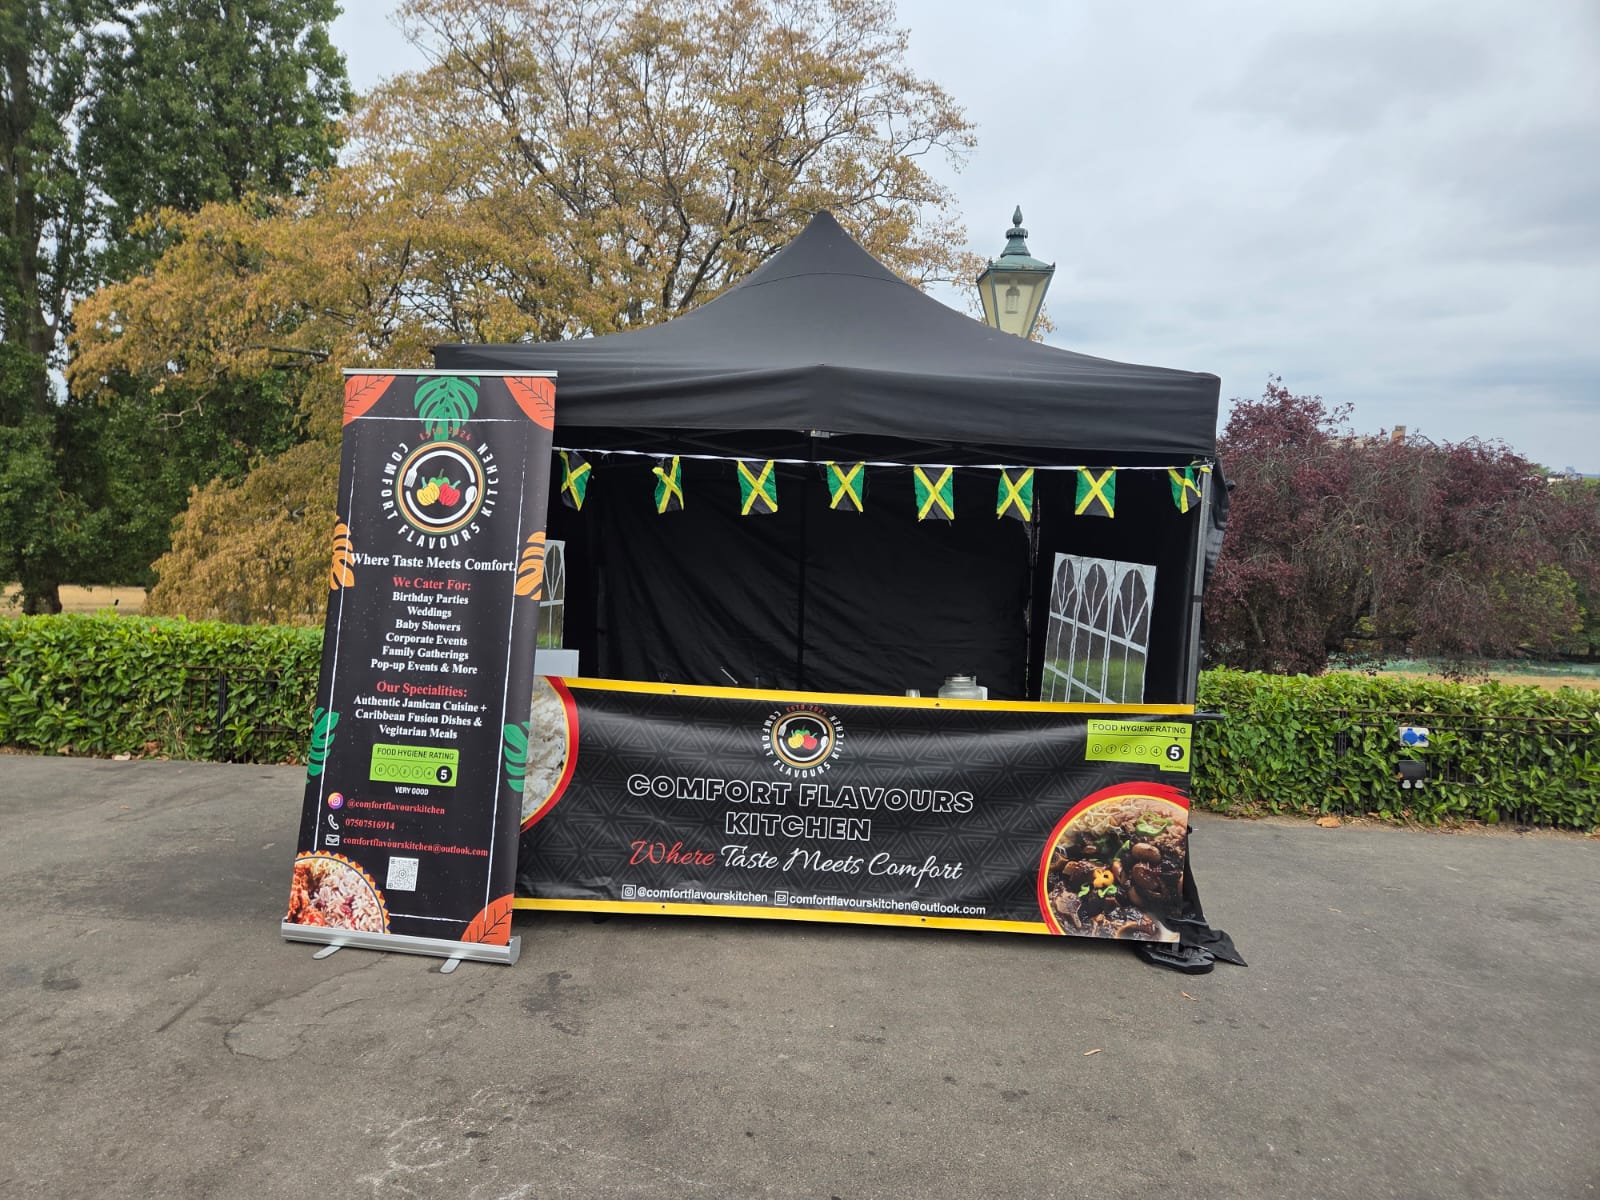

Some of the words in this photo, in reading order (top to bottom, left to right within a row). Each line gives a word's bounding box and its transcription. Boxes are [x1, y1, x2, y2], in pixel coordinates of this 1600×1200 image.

[381, 442, 409, 520] COMFORT
[397, 522, 480, 549] FLAVOURS
[480, 442, 499, 517] KITCHEN
[351, 552, 389, 566] Where
[392, 554, 423, 568] Taste
[427, 556, 461, 569] Meets
[393, 576, 410, 588] We
[413, 577, 444, 589] Cater
[447, 579, 471, 591] For:
[392, 591, 434, 605] Birthday
[436, 593, 469, 605] Parties
[407, 606, 452, 619] Weddings
[395, 619, 420, 631] Baby
[422, 620, 461, 632] Showers
[385, 632, 434, 645] Corporate
[436, 635, 468, 646] Events
[382, 645, 415, 658] Family
[417, 648, 469, 662] Gatherings
[370, 658, 405, 671] Pop-up
[407, 661, 438, 672] Events
[440, 663, 449, 673] &
[452, 664, 478, 674] More
[376, 680, 400, 693] Our
[402, 682, 468, 697] Specialities:
[353, 695, 400, 707] Authentic
[402, 698, 441, 710] Jamican
[443, 701, 479, 712] Cuisine
[480, 704, 487, 712] +
[355, 709, 405, 722] Caribbean
[407, 712, 439, 724] Fusion
[441, 714, 471, 726] Dishes
[473, 717, 483, 727] &
[379, 724, 427, 738] Vegitarian
[429, 727, 457, 739] Meals
[1092, 723, 1118, 731] FOOD
[1120, 725, 1155, 733] HYGIENE
[1155, 726, 1186, 734] RATING
[762, 711, 781, 756] COMFORT
[773, 760, 831, 778] FLAVOURS
[829, 715, 844, 760] KITCHEN
[1169, 746, 1180, 759] 5
[377, 748, 396, 756] FOOD
[397, 749, 426, 758] HYGIENE
[429, 751, 454, 760] RATING
[440, 769, 448, 780] 5
[394, 786, 411, 794] VERY
[411, 787, 429, 796] GOOD
[626, 773, 792, 805] COMFORT
[799, 783, 974, 814] FLAVOURS
[346, 799, 445, 815] @comfortflavourskitchen
[725, 811, 872, 842] KITCHEN
[343, 837, 488, 857] comfortflavourskitchen@outlook.com
[628, 839, 716, 867] Where
[720, 844, 779, 870] Taste
[782, 847, 865, 875] Meets
[868, 852, 964, 888] Comfort
[637, 886, 768, 903] @comfortflavourskitchen
[789, 894, 986, 915] comfortflavourskitchen@outlook.com
